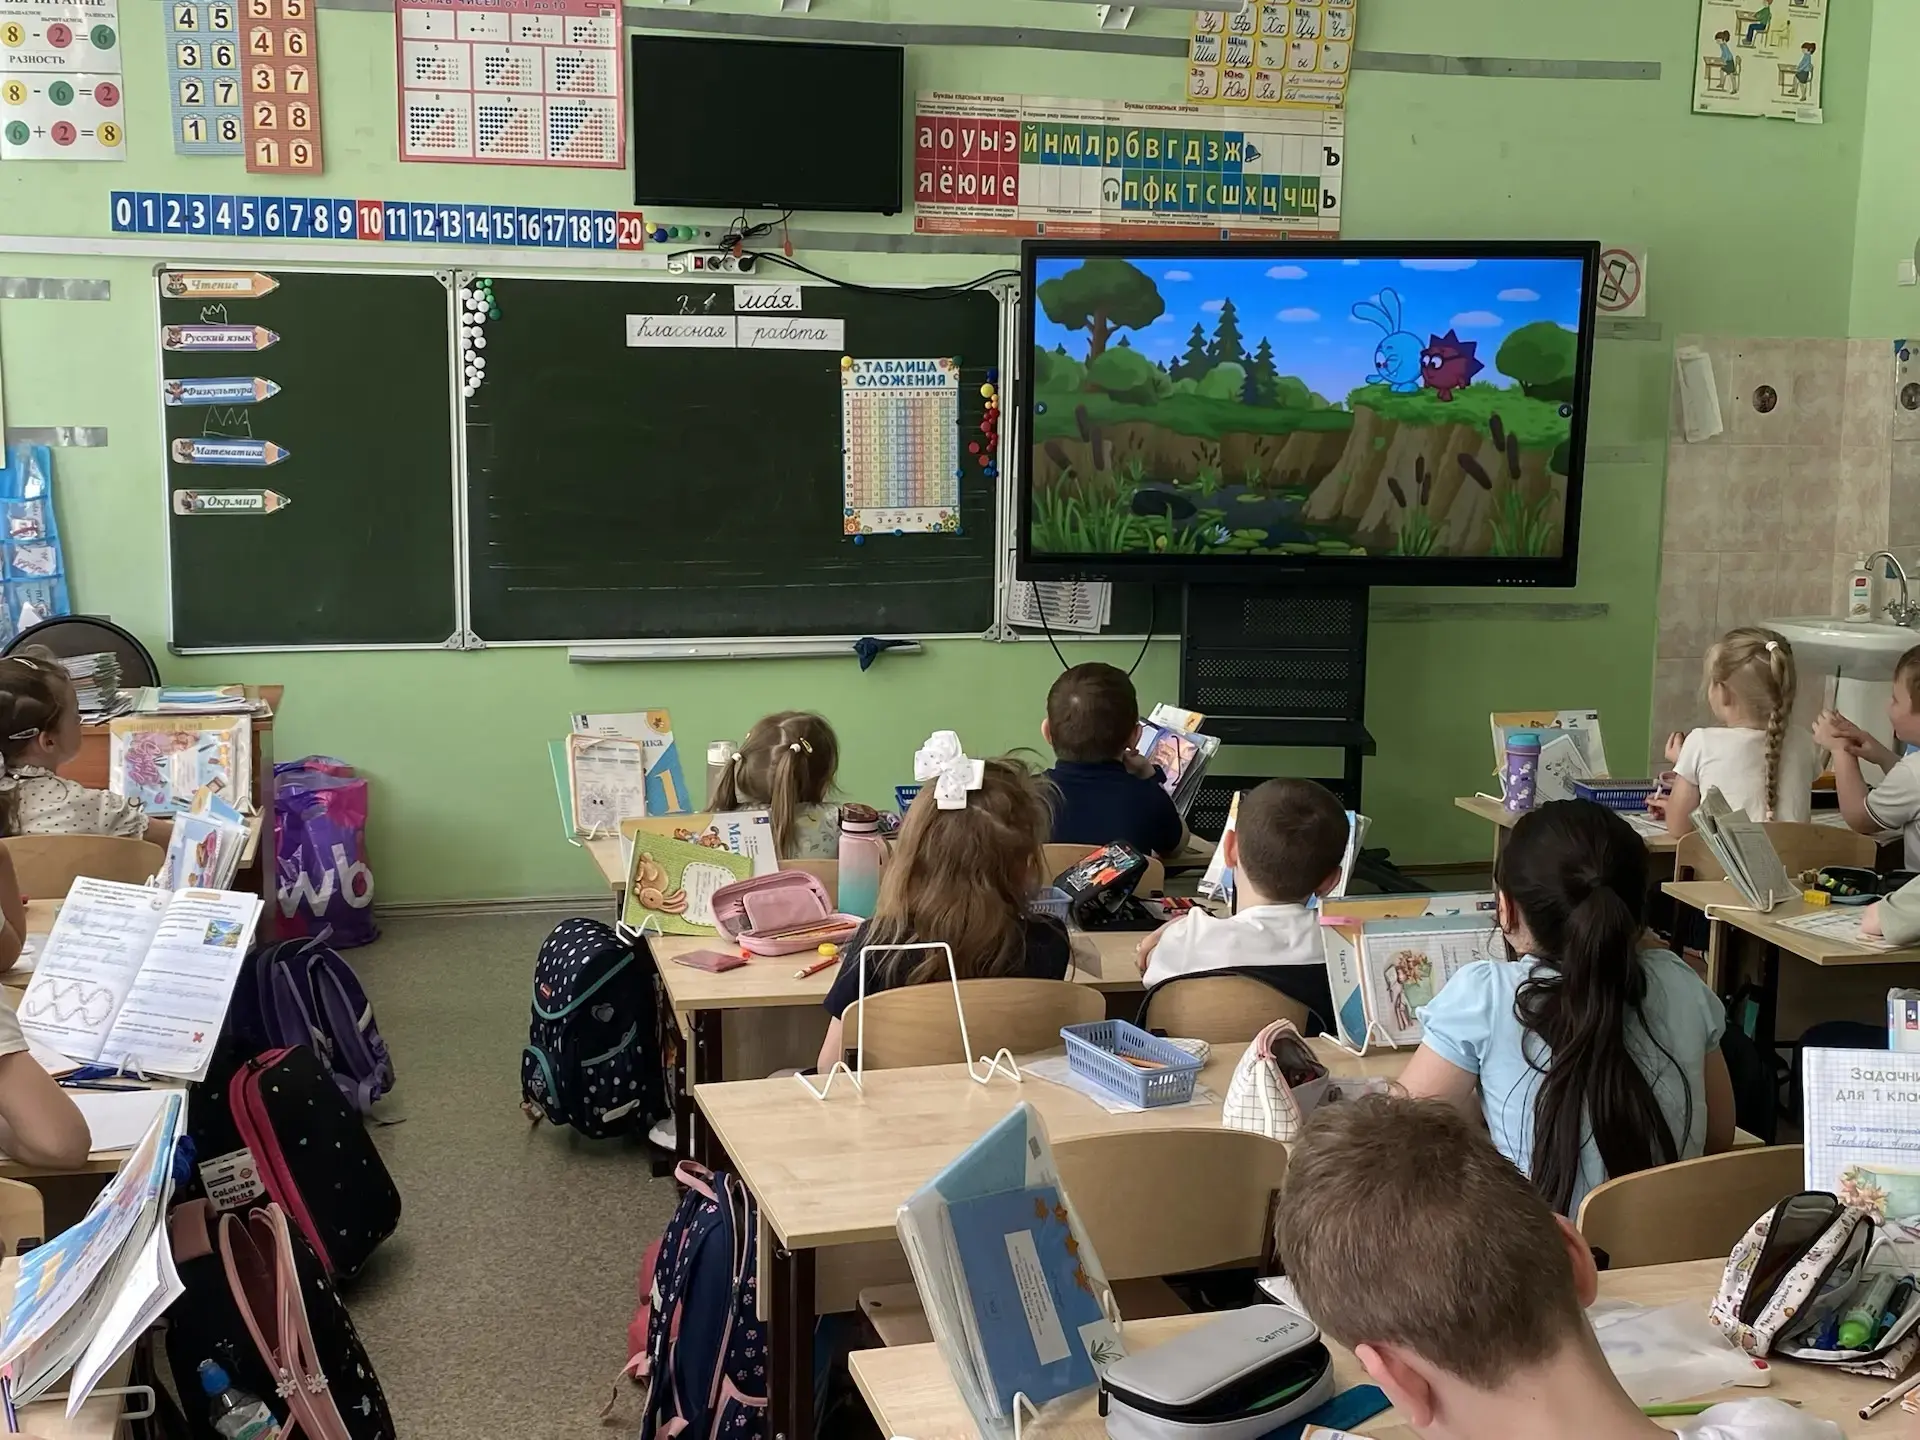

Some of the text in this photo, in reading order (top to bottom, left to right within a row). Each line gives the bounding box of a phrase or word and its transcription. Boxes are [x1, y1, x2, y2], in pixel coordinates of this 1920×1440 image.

[254, 0, 301, 16] 5 5
[534, 2, 550, 10] до
[554, 2, 566, 10] 10
[180, 8, 228, 28] 4 5
[8, 26, 107, 44] 8 2 6
[1262, 17, 1286, 34] Хх
[1296, 19, 1316, 38] Цц
[1332, 21, 1346, 37] Чч
[254, 34, 302, 53] 4 6
[9, 55, 66, 64] РАЗНОСТЬ
[182, 46, 231, 66] 3 6
[1194, 45, 1218, 62] Шш
[1226, 47, 1252, 68] Щщ
[257, 71, 304, 90] 3 7
[1194, 79, 1209, 96] Ээ
[1223, 82, 1246, 97] Юю
[1256, 83, 1275, 100] Яя
[10, 86, 112, 102] 8 6 2
[185, 83, 234, 103] 2 7
[933, 92, 954, 100] Буквы
[955, 94, 982, 102] гласных
[1124, 102, 1143, 110] Буквы
[1144, 103, 1177, 112] согласных
[259, 108, 306, 127] 2 8
[12, 125, 116, 142] 6 2 8
[190, 121, 236, 140] 1 8
[262, 144, 308, 164] 1 9
[919, 127, 932, 148] а
[941, 128, 954, 149] о
[962, 129, 975, 157] у
[981, 130, 998, 151] ы
[1004, 131, 1016, 152] э
[1024, 125, 1037, 153] й
[1045, 134, 1057, 154] н
[1063, 134, 1080, 154] м
[1086, 135, 1100, 156] л
[1106, 136, 1119, 164] р
[1126, 130, 1139, 158] б
[1147, 139, 1159, 159] в
[1167, 139, 1177, 159] г
[1185, 140, 1200, 165] д
[1207, 142, 1218, 161] з
[1224, 142, 1241, 161] ж
[919, 172, 932, 192] я
[940, 166, 952, 193] ё
[959, 174, 977, 195] ю
[982, 175, 994, 195] и
[1003, 176, 1015, 196] е
[1125, 181, 1137, 200] п
[1143, 176, 1159, 209] ф
[1165, 183, 1177, 202] к
[1186, 184, 1198, 203] т
[1206, 185, 1216, 204] с
[1222, 185, 1239, 205] ш
[1245, 186, 1256, 205] х
[1263, 187, 1276, 211] ц
[1284, 187, 1296, 207] ч
[1302, 188, 1318, 212] щ
[116, 198, 642, 245] 0 1 2 3 4 5 6 7 8 9 10 11 12 13 14 15 16 17 18 19 20
[192, 280, 238, 290] Чтение
[184, 333, 251, 344] Русский язык
[636, 317, 828, 346] Классная работа
[863, 361, 937, 373] ТАБЛИЦА
[856, 374, 946, 386] СЛОЖЕНИЯ
[186, 386, 252, 396] Физкультура
[194, 446, 263, 457] Математика
[207, 496, 257, 506] Окр.мир
[654, 769, 686, 814] 1
[1851, 1067, 1920, 1083] Задачни
[1836, 1088, 1920, 1102] для 1 кла
